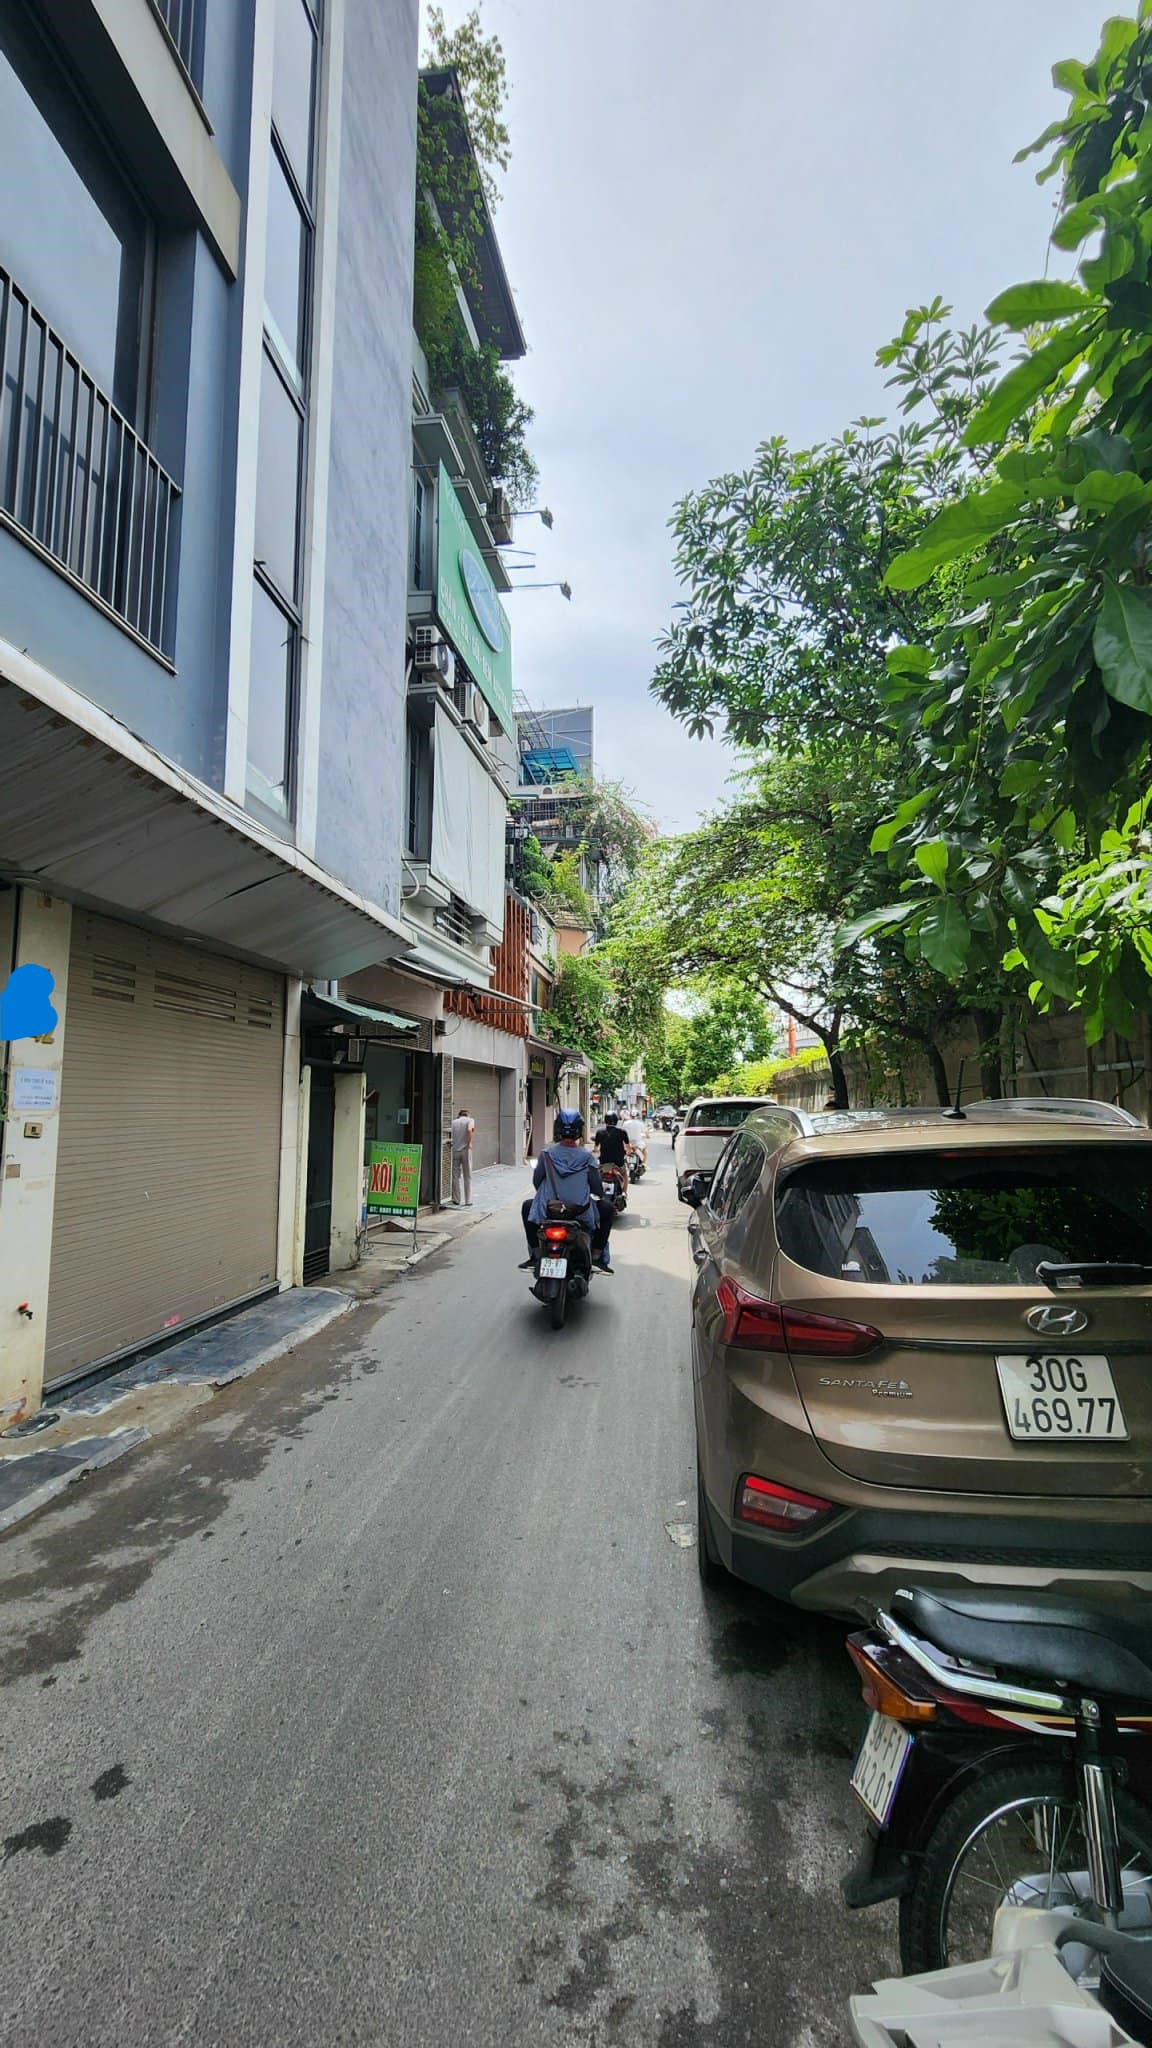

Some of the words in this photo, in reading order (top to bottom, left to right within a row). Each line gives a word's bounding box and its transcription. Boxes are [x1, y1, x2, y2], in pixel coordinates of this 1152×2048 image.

[371, 1158, 392, 1193] XÔI
[1025, 1357, 1088, 1393] 30G
[1014, 1397, 1116, 1435] 469.77
[855, 1748, 894, 1819] 042.01
